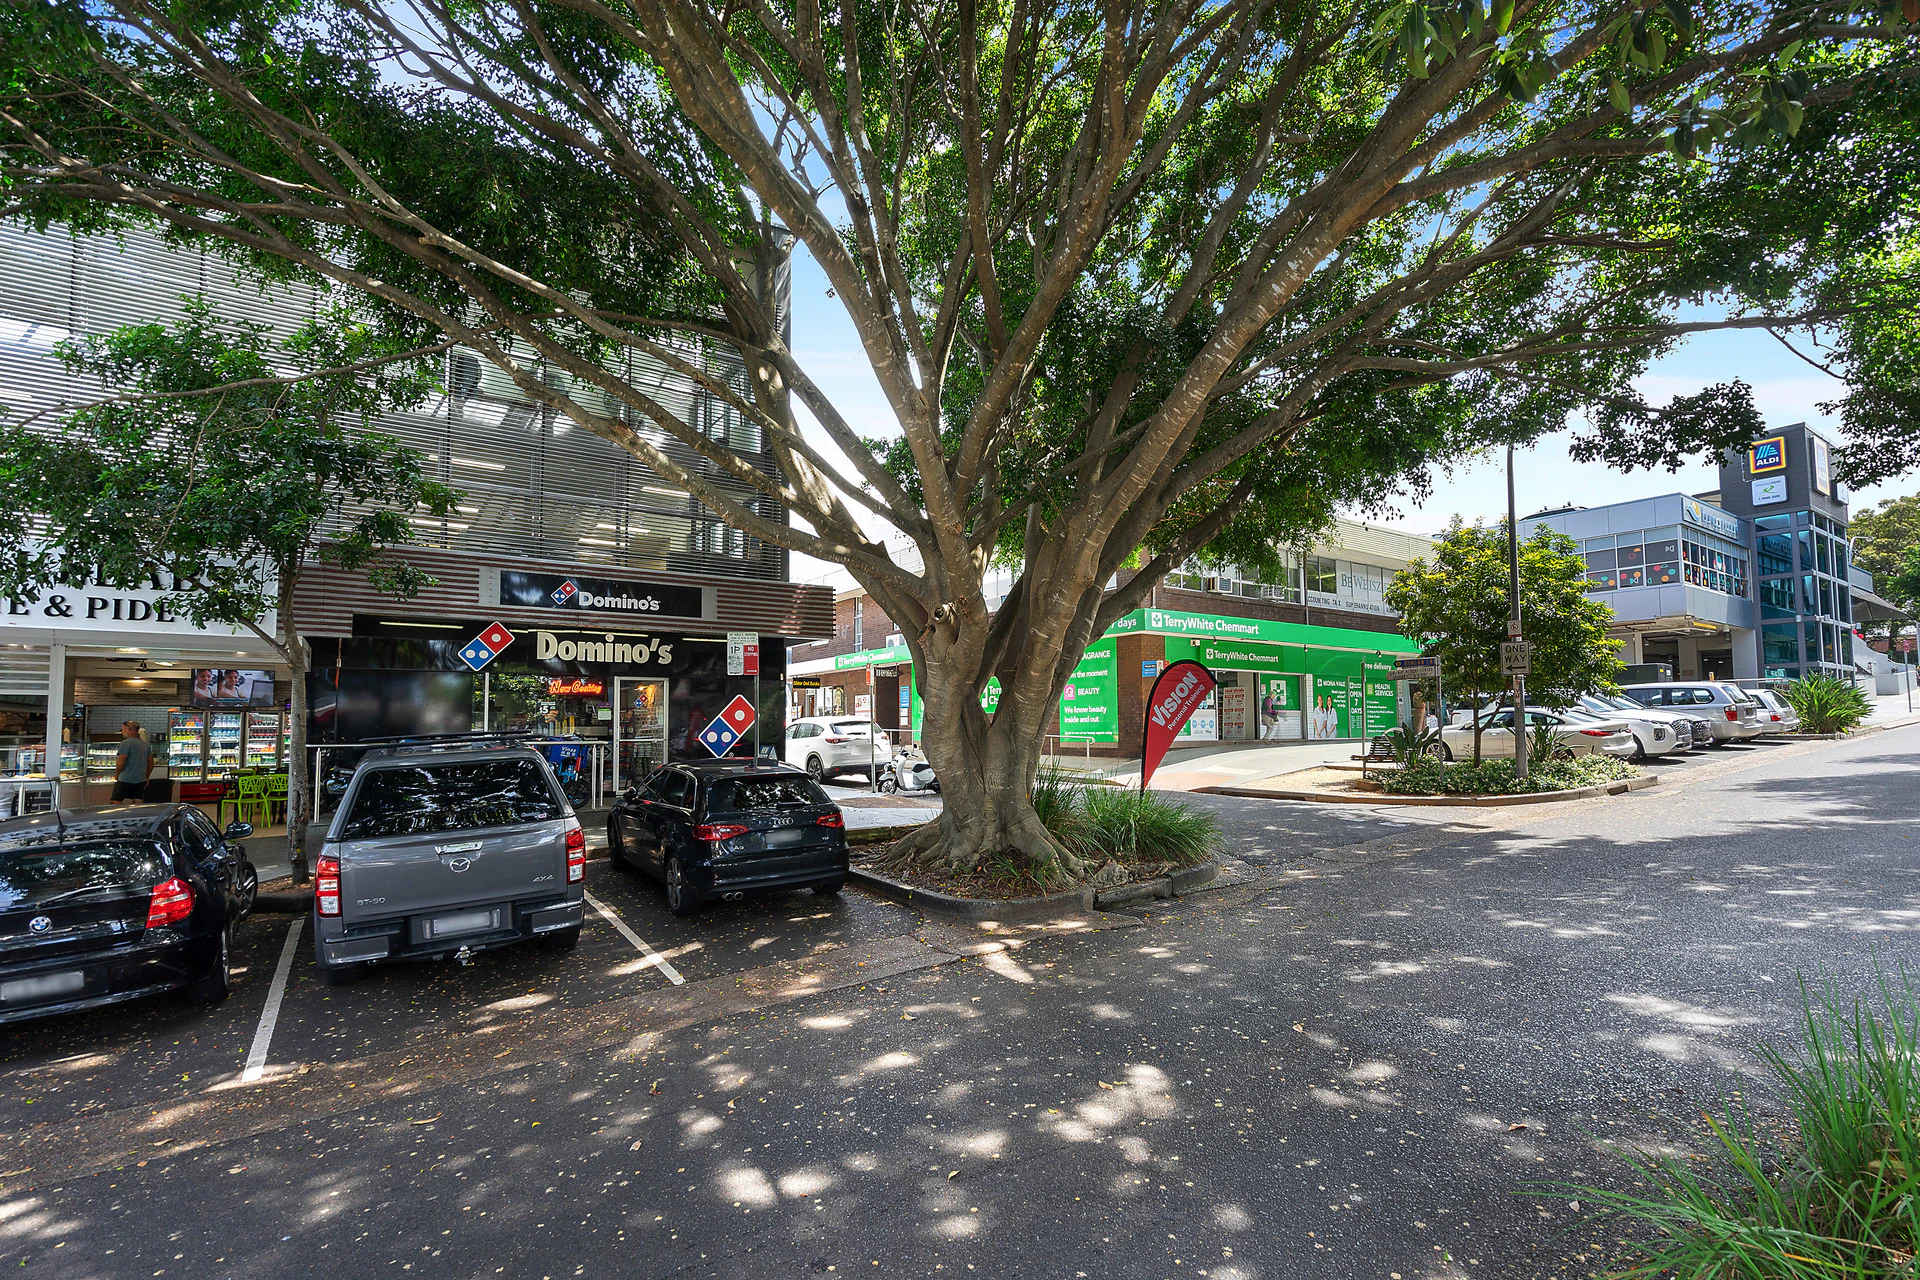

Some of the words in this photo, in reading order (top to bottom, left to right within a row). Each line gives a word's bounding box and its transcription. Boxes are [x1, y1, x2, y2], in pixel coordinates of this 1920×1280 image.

[1756, 457, 1780, 466] ALDI
[578, 592, 660, 611] Domino's
[1308, 596, 1330, 605] CCOUNTING
[44, 594, 73, 618] &
[85, 596, 175, 622] PIDE
[1118, 618, 1136, 629] days
[1164, 614, 1214, 630] TerryWhite
[1216, 620, 1259, 634] Chemmart
[536, 632, 673, 664] Domino's
[1506, 644, 1525, 653] ONE
[1082, 650, 1110, 660] AGRANCE
[1214, 650, 1248, 661] TerryWhite
[1248, 654, 1279, 662] Chemmart
[1504, 654, 1526, 663] WAY
[1374, 662, 1392, 670] delivery
[1086, 669, 1108, 677] moment
[1078, 688, 1100, 696] BEAUTY
[1152, 671, 1198, 726] VISION
[1089, 706, 1107, 714] beauty
[1167, 704, 1188, 730] Personal
[1184, 684, 1206, 706] Training
[356, 897, 386, 906] BT-50
